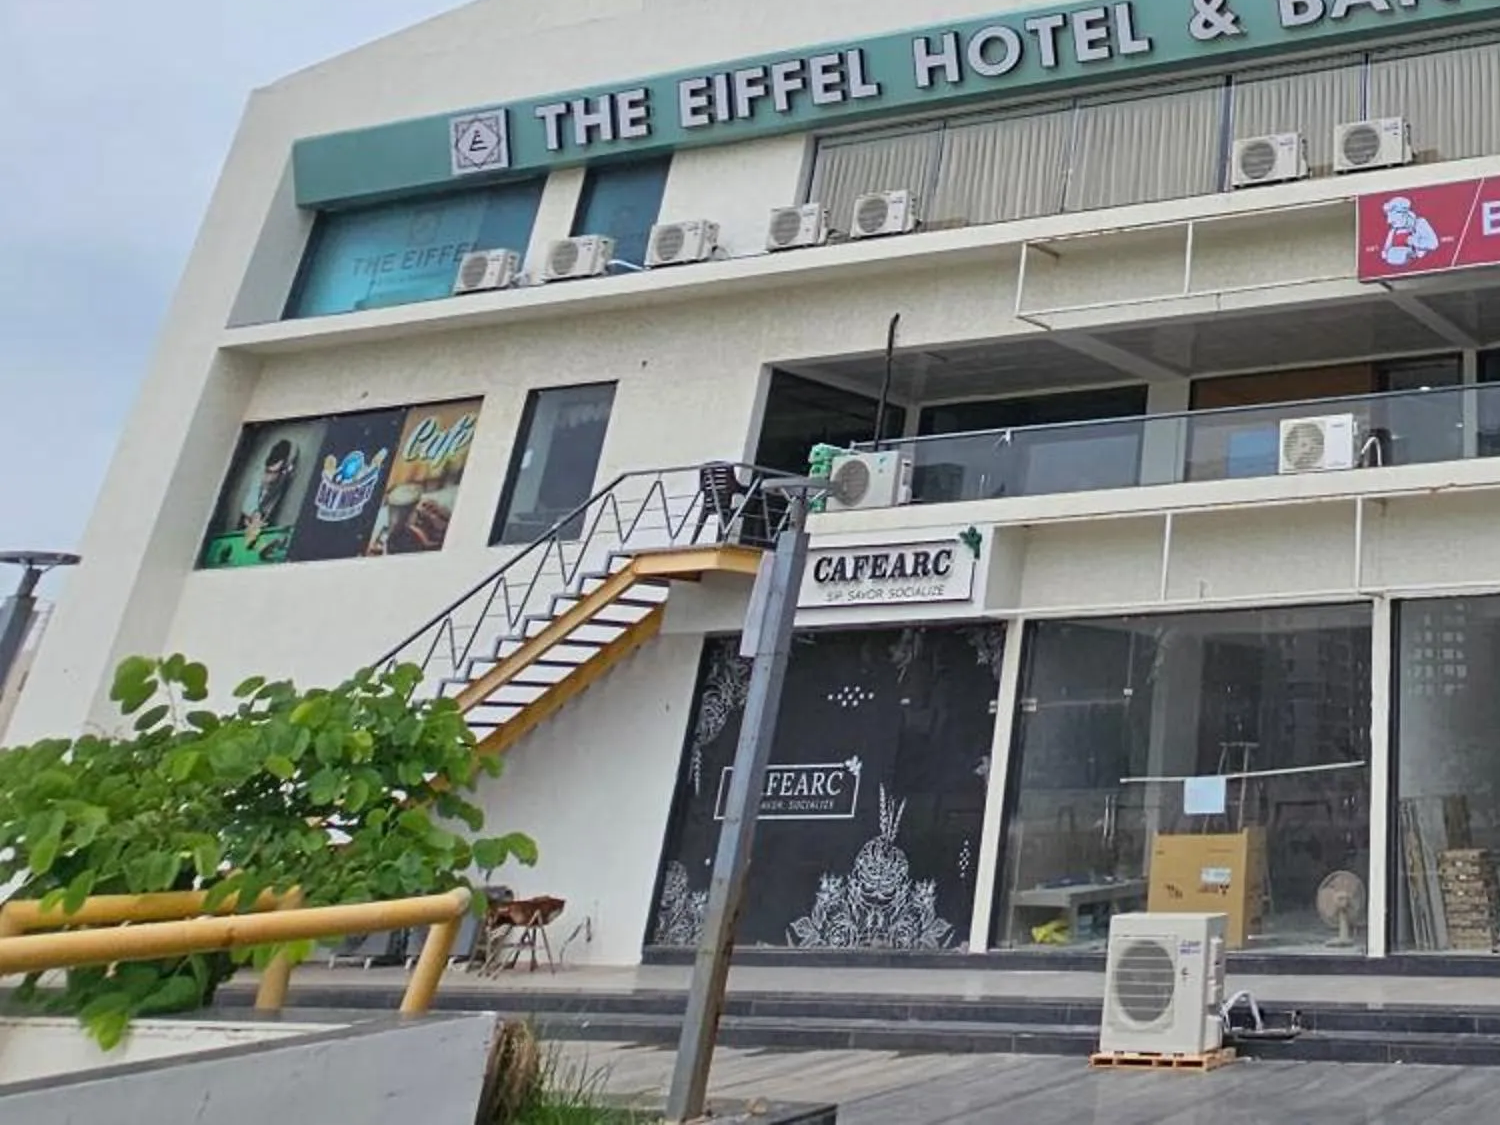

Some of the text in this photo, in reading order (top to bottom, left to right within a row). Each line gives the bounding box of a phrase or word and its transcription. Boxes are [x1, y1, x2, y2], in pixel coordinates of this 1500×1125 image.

[535, 87, 652, 151] THE
[678, 48, 882, 129] EIFFEL
[912, 1, 1152, 89] HOTEL
[352, 252, 397, 277] THE
[813, 549, 954, 584] CAFEARC
[847, 587, 885, 602] SAVOR
[887, 584, 946, 600] SOCIALIZE
[761, 770, 845, 797] FEARC
